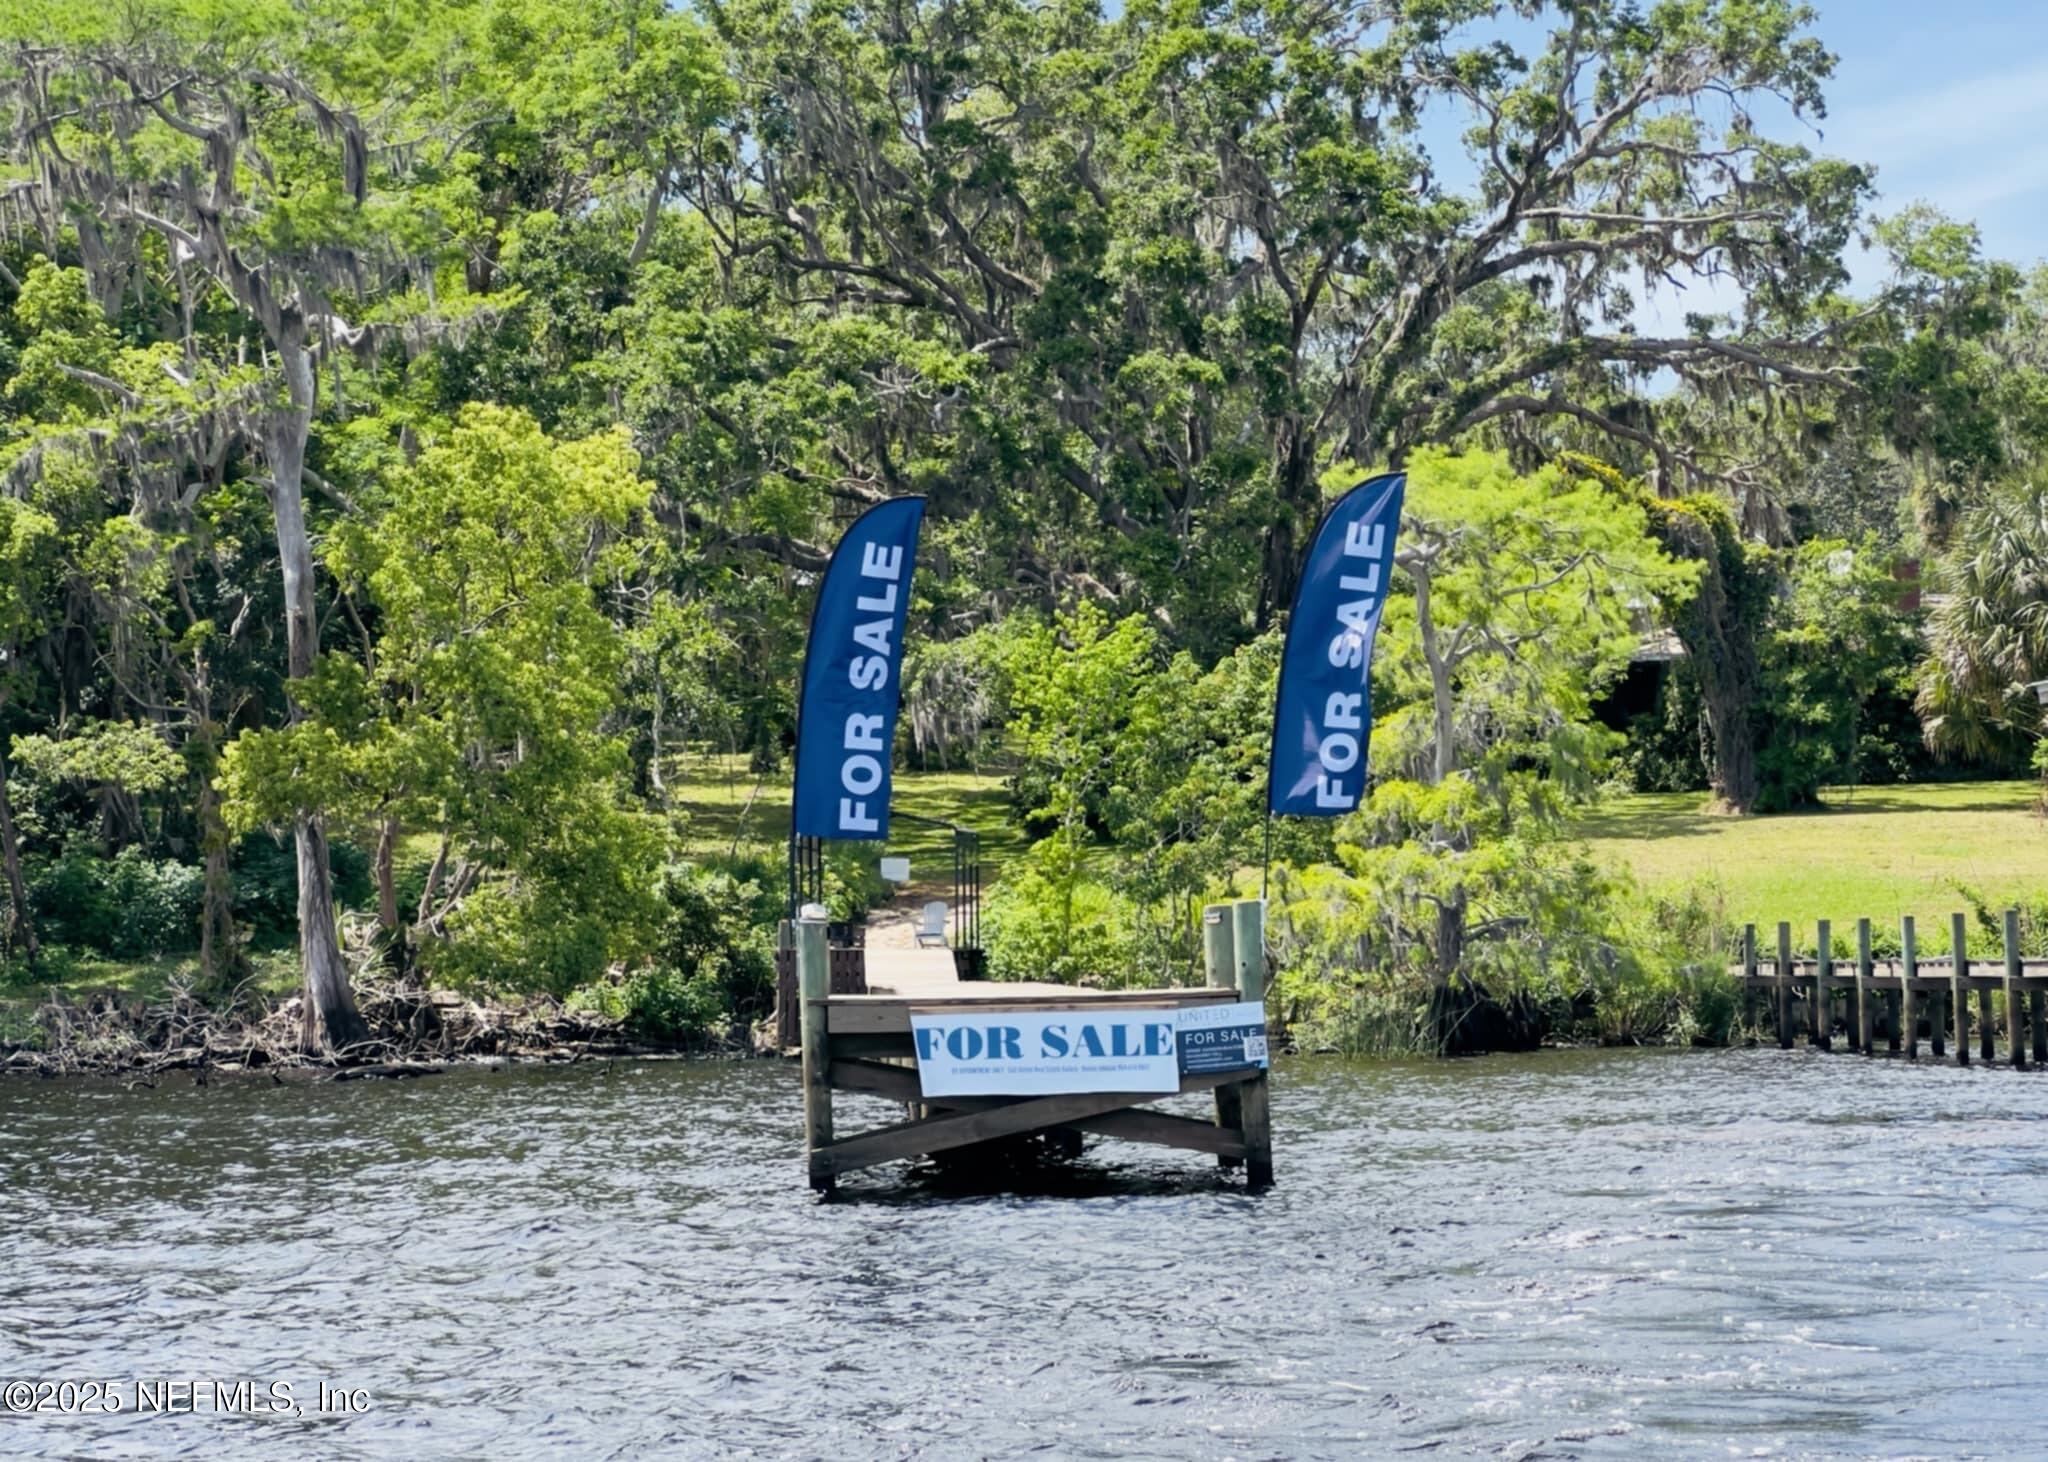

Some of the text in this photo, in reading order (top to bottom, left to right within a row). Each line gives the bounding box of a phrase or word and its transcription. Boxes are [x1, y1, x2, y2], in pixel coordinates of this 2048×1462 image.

[1316, 521, 1385, 809] FOR SALE
[839, 541, 903, 833] FOR SALE
[1178, 1008, 1230, 1022] UNITED
[915, 1023, 1174, 1061] FOR SALE
[1185, 1032, 1215, 1045] FOR
